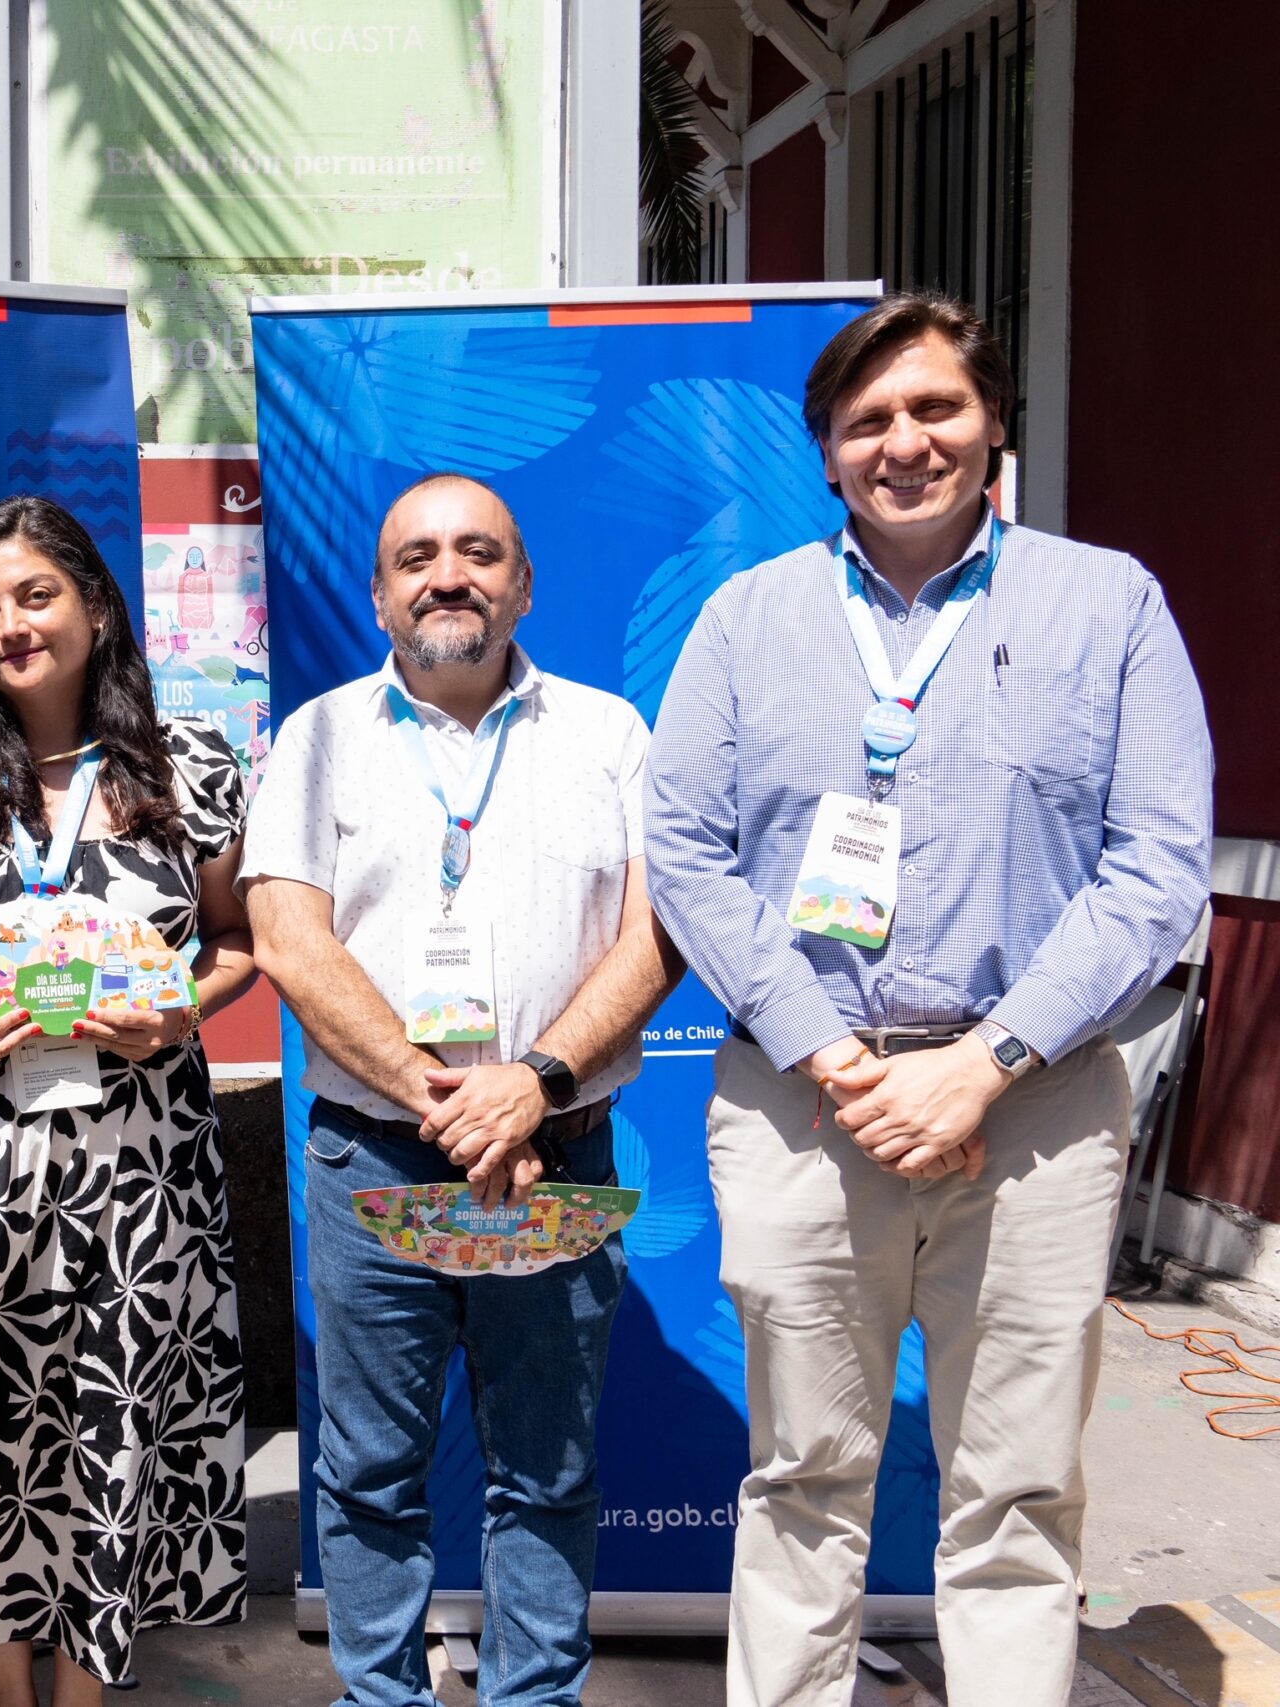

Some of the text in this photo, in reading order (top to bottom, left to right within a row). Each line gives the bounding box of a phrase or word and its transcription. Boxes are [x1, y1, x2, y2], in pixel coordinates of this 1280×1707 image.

[293, 152, 486, 183] permanente
[163, 681, 193, 706] LOS
[831, 843, 880, 864] PATRIMONIAL
[426, 957, 470, 967] PATRIMONIAL
[36, 972, 72, 986] DÍA DE LOS
[24, 983, 86, 999] PATRIMONIOS
[664, 1028, 683, 1041] de
[686, 1026, 725, 1040] Chile
[455, 1210, 524, 1221] PATRIMONIOS
[469, 1220, 483, 1230] LOS
[484, 1220, 494, 1229] DE
